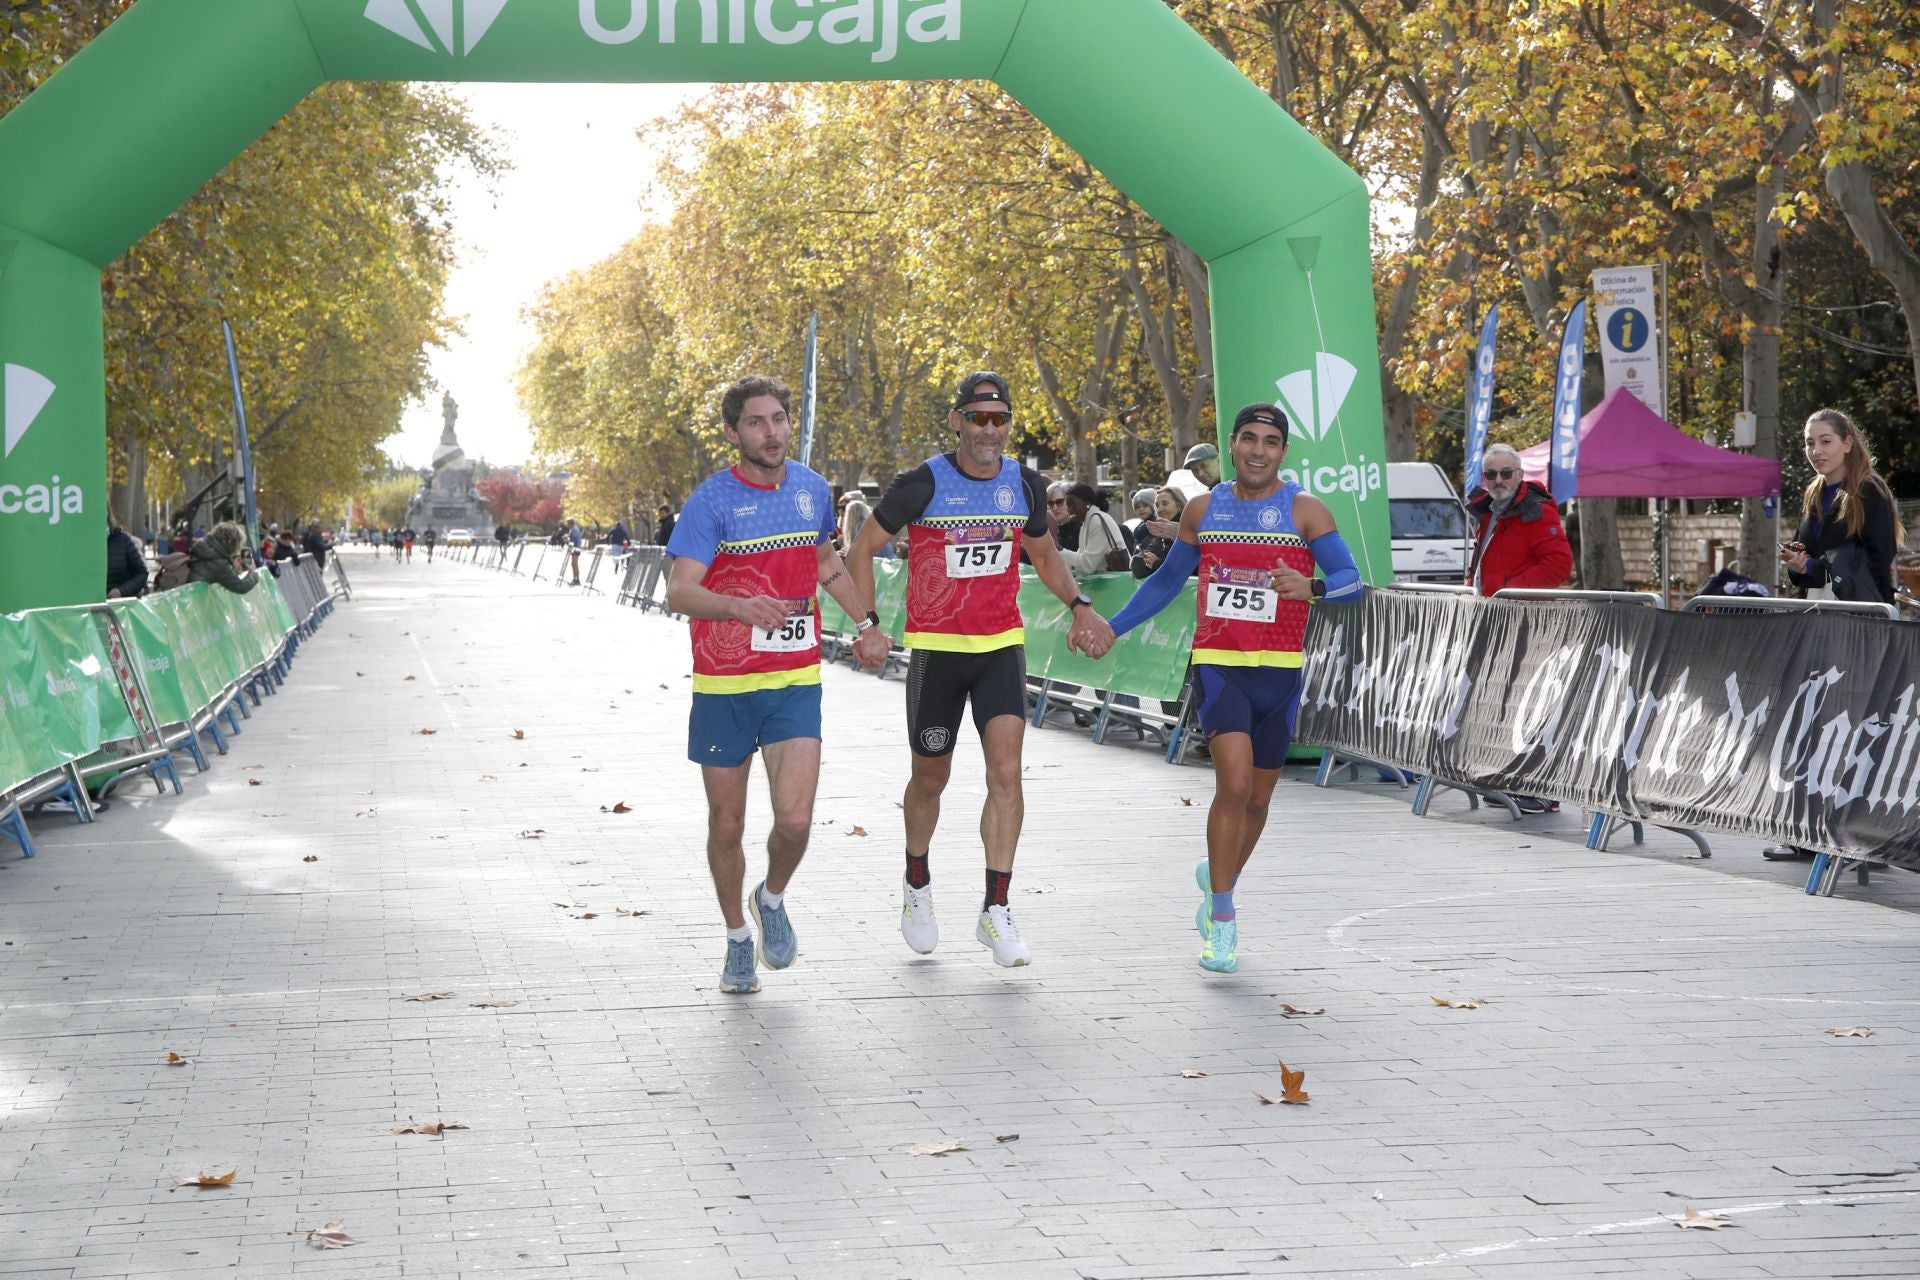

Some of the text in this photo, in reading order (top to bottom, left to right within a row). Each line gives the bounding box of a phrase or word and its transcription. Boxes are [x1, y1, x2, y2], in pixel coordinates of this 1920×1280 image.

[1601, 275, 1637, 285] Oficina de
[1559, 343, 1580, 470] IVECO
[1277, 454, 1381, 502] nicaja
[955, 545, 1002, 568] 757
[1216, 586, 1266, 611] 755
